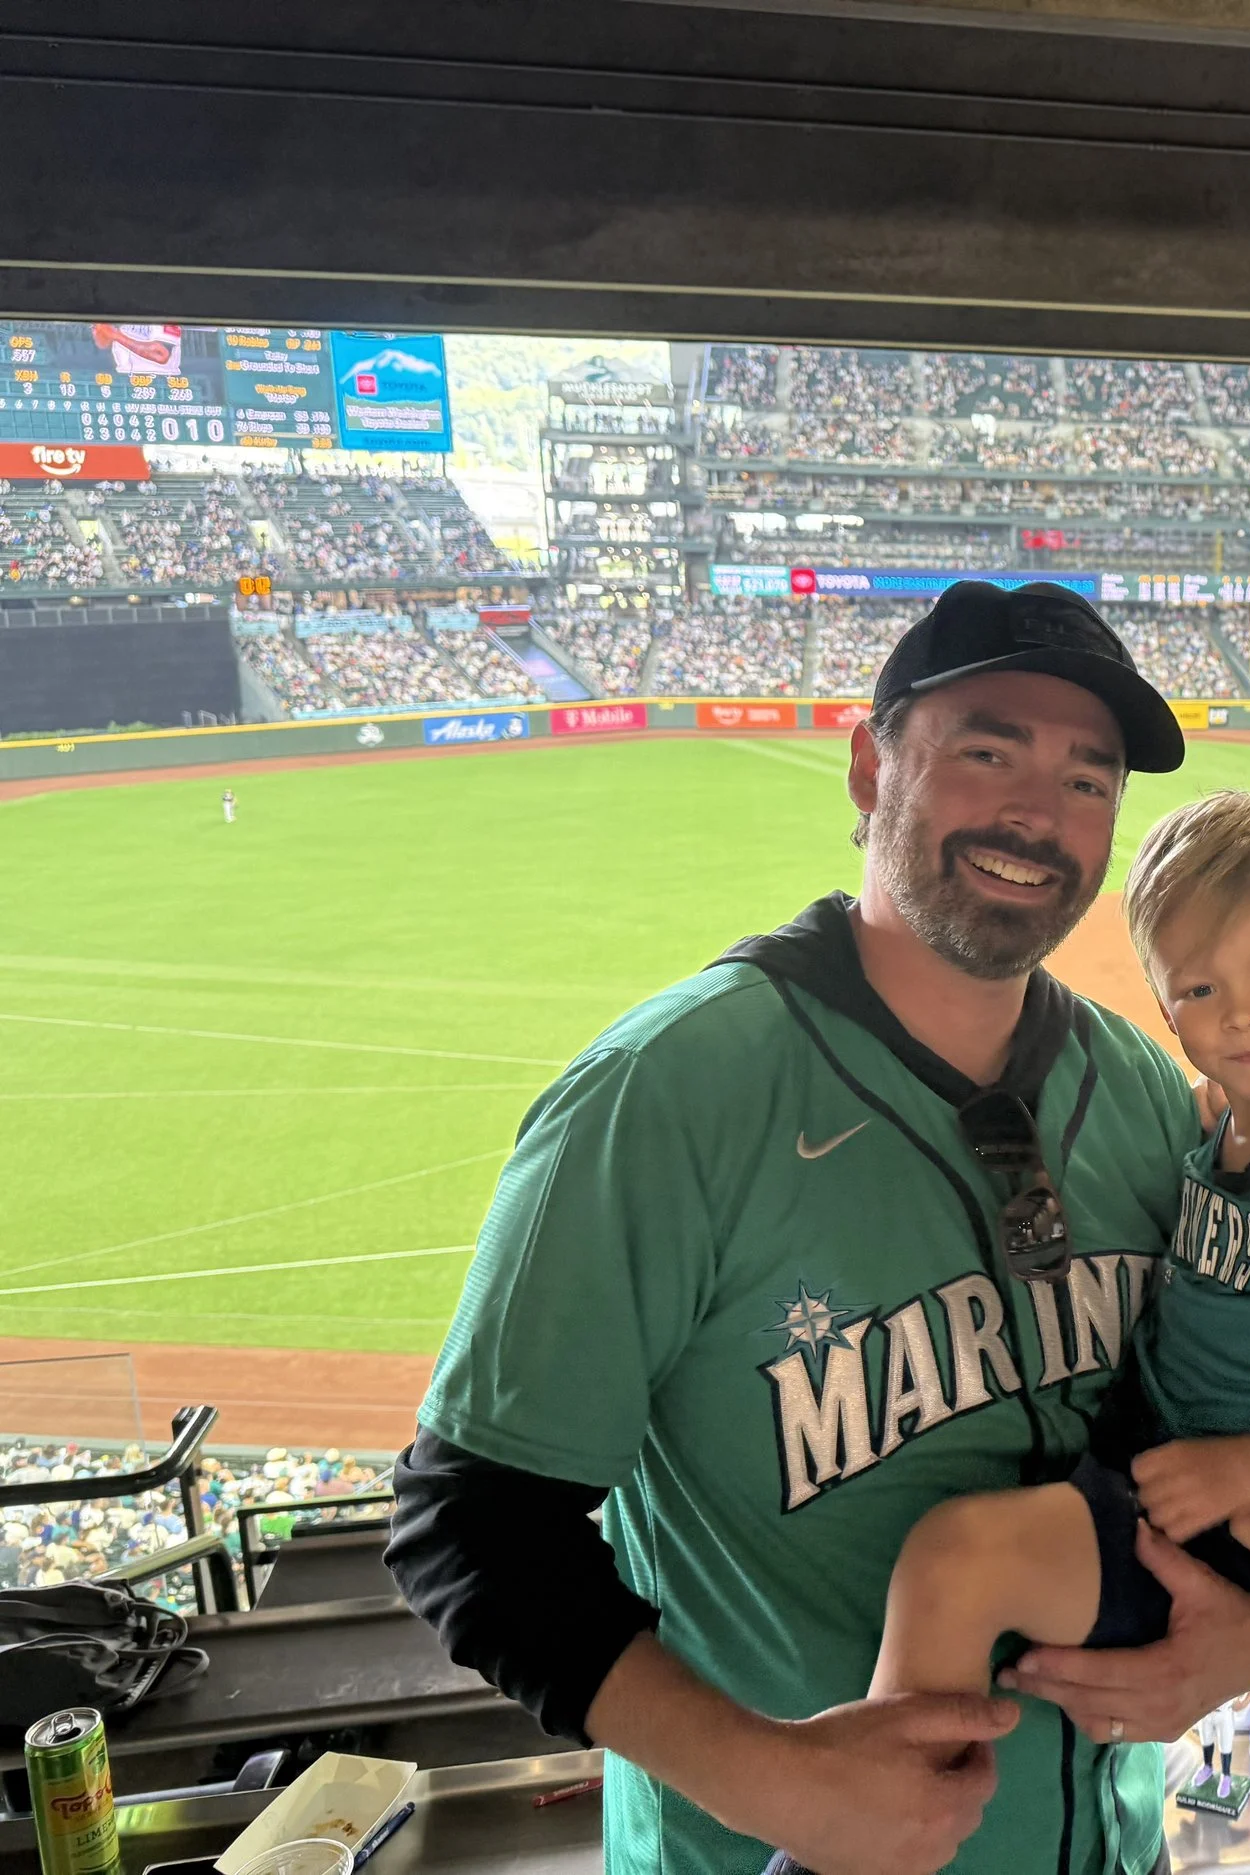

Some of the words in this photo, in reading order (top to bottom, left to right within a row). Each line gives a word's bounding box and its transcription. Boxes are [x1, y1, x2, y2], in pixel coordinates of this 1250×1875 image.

[23, 382, 33, 394] 3
[83, 427, 94, 440] 2
[100, 427, 110, 440] 3
[146, 428, 156, 441] 2
[162, 418, 179, 441] 0
[186, 419, 199, 441] 1
[207, 419, 224, 441] 0
[31, 445, 65, 464] fire
[65, 447, 86, 465] tv
[815, 575, 871, 589] TOYOTA
[581, 706, 633, 727] Mobile
[430, 718, 496, 742] Alaska
